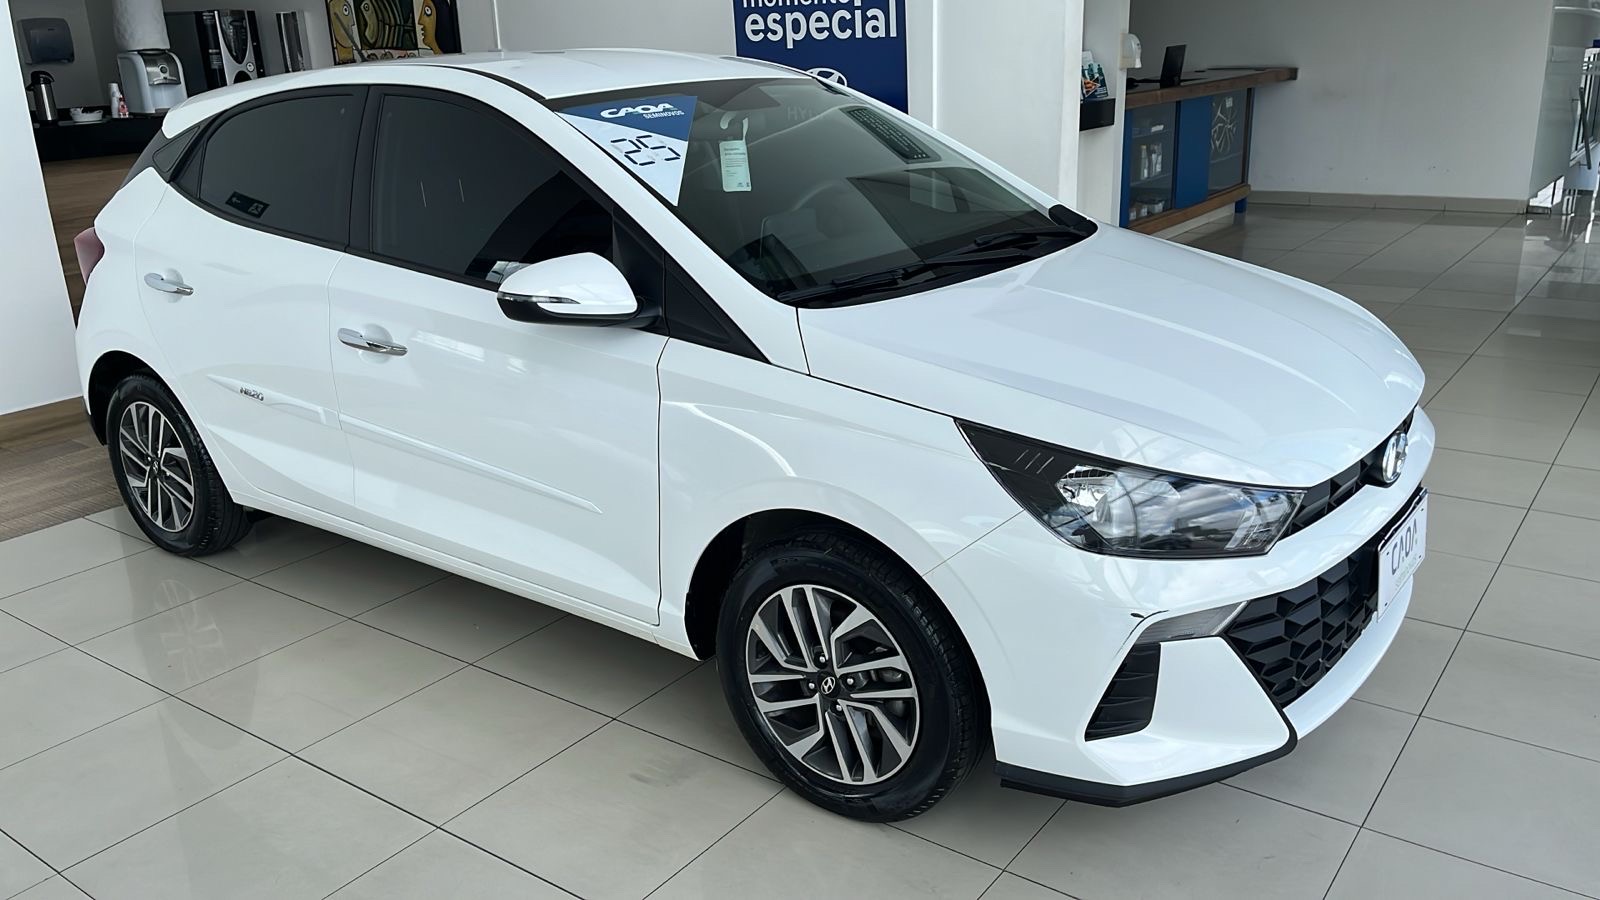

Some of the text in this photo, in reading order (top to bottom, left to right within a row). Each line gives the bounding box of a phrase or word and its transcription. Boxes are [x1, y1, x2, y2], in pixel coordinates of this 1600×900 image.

[744, 0, 897, 49] especial
[600, 102, 675, 118] CAOA
[642, 110, 685, 119] SEMINOVOS
[1391, 518, 1418, 576] CAOA
